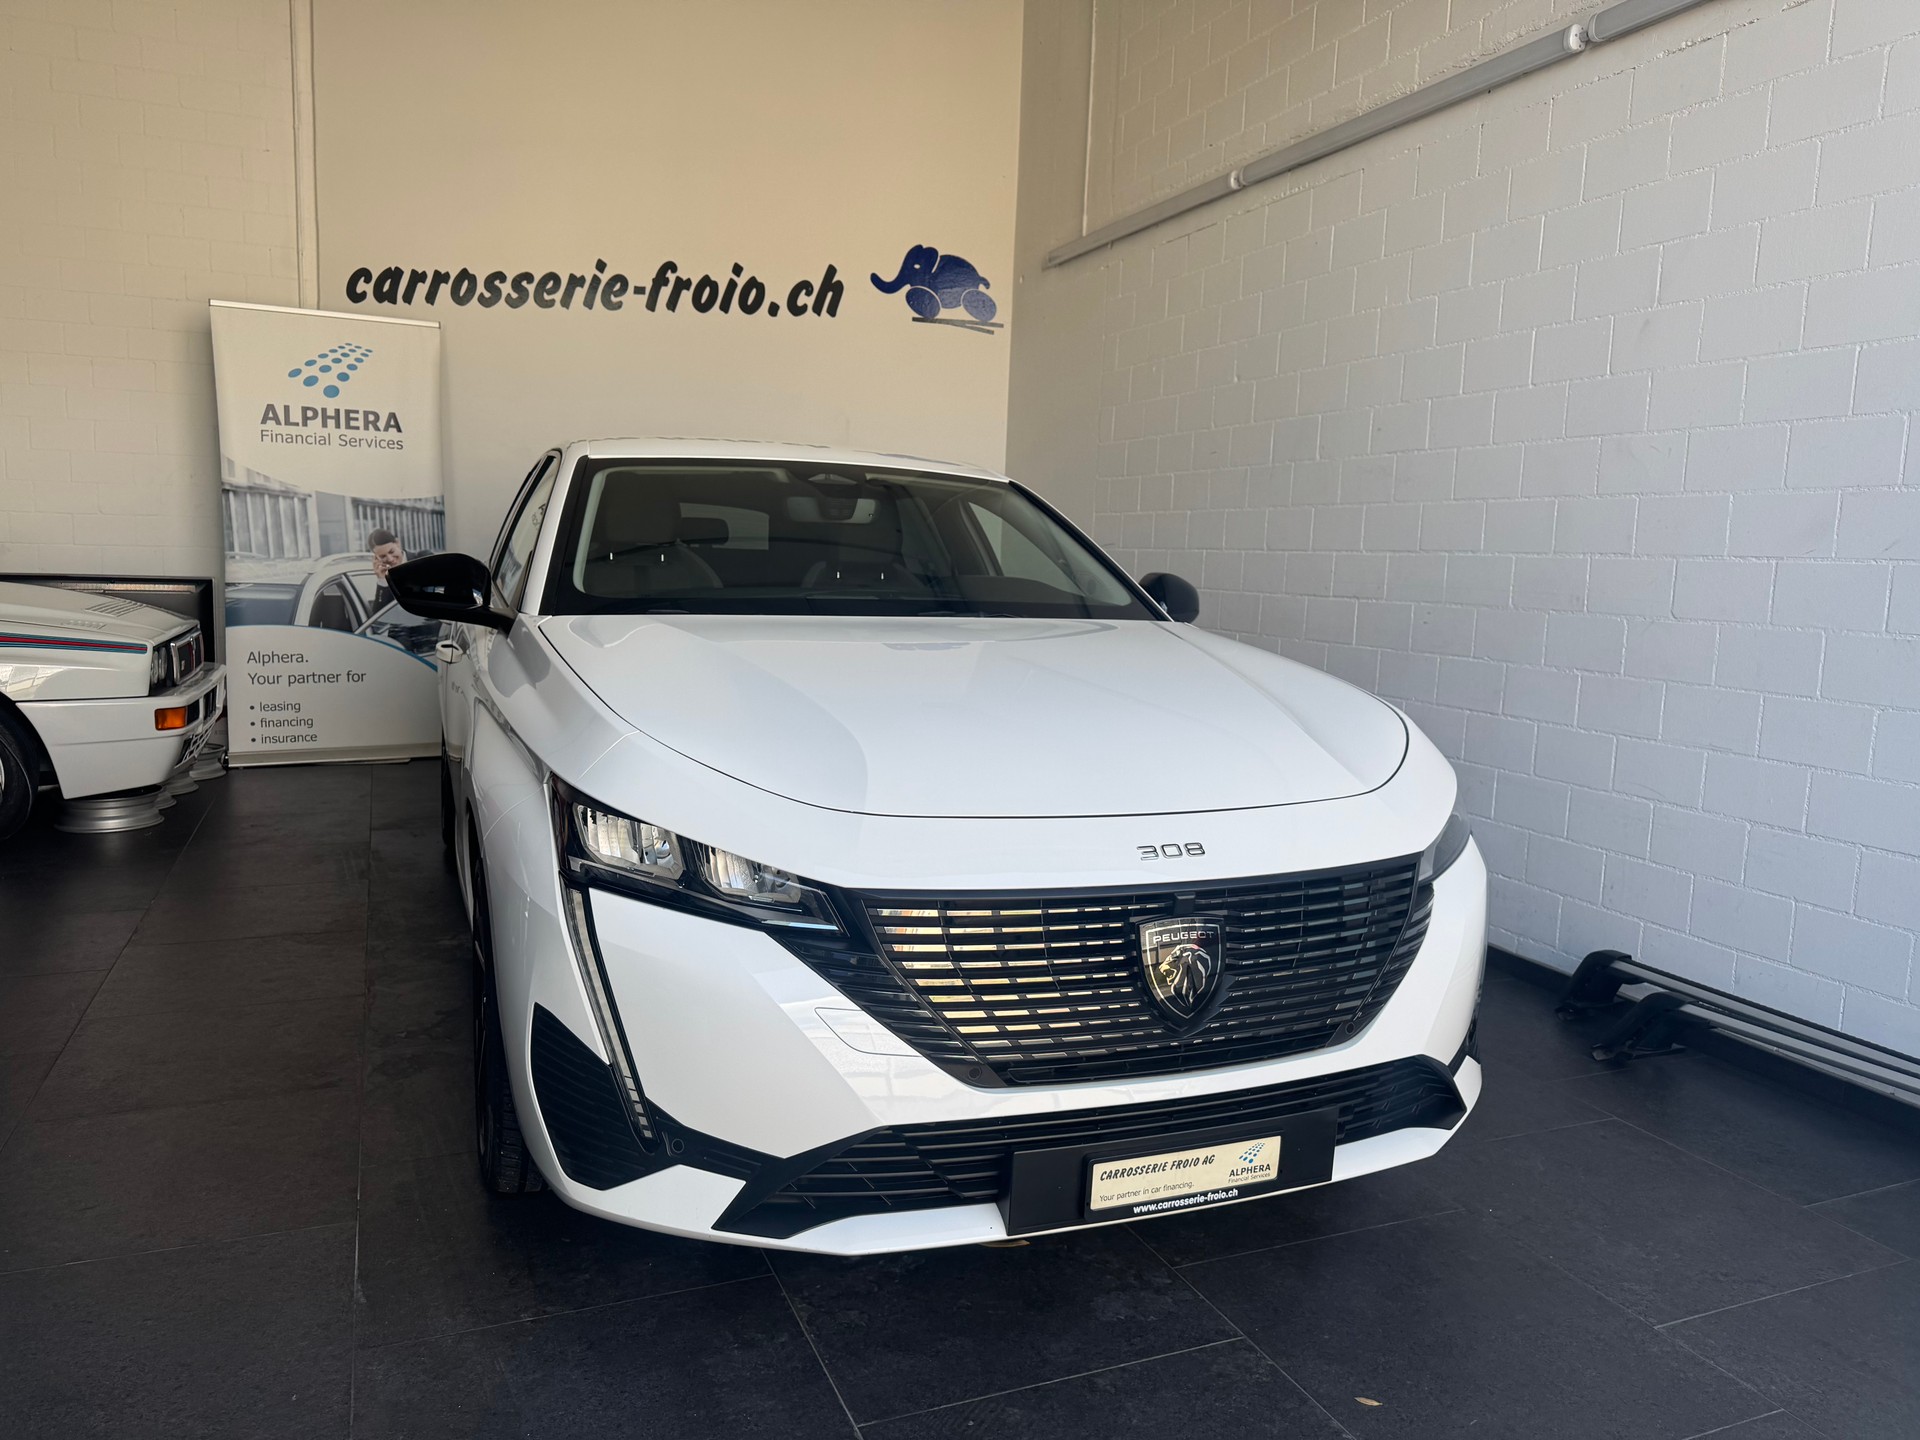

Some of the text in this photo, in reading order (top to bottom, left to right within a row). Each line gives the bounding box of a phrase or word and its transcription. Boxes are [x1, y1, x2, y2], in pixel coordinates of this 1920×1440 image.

[345, 258, 845, 318] carrosserie-froio.ch
[260, 403, 403, 433] ALPHERA
[260, 429, 404, 450] Financial Services
[247, 651, 309, 667] Alphera.
[247, 670, 367, 687] Your partner for
[259, 701, 301, 714] leasing
[260, 717, 314, 730] financing
[261, 733, 318, 745] insurance
[1137, 842, 1206, 861] 308
[1153, 931, 1214, 944] PEUGEOT
[1100, 1154, 1216, 1181] CARROSSERIE FROIO AG
[1228, 1163, 1271, 1178] ALPHERA
[1099, 1180, 1195, 1202] Your partner in car financing.
[1133, 1188, 1239, 1214] www.carrosserie-froio.ch
